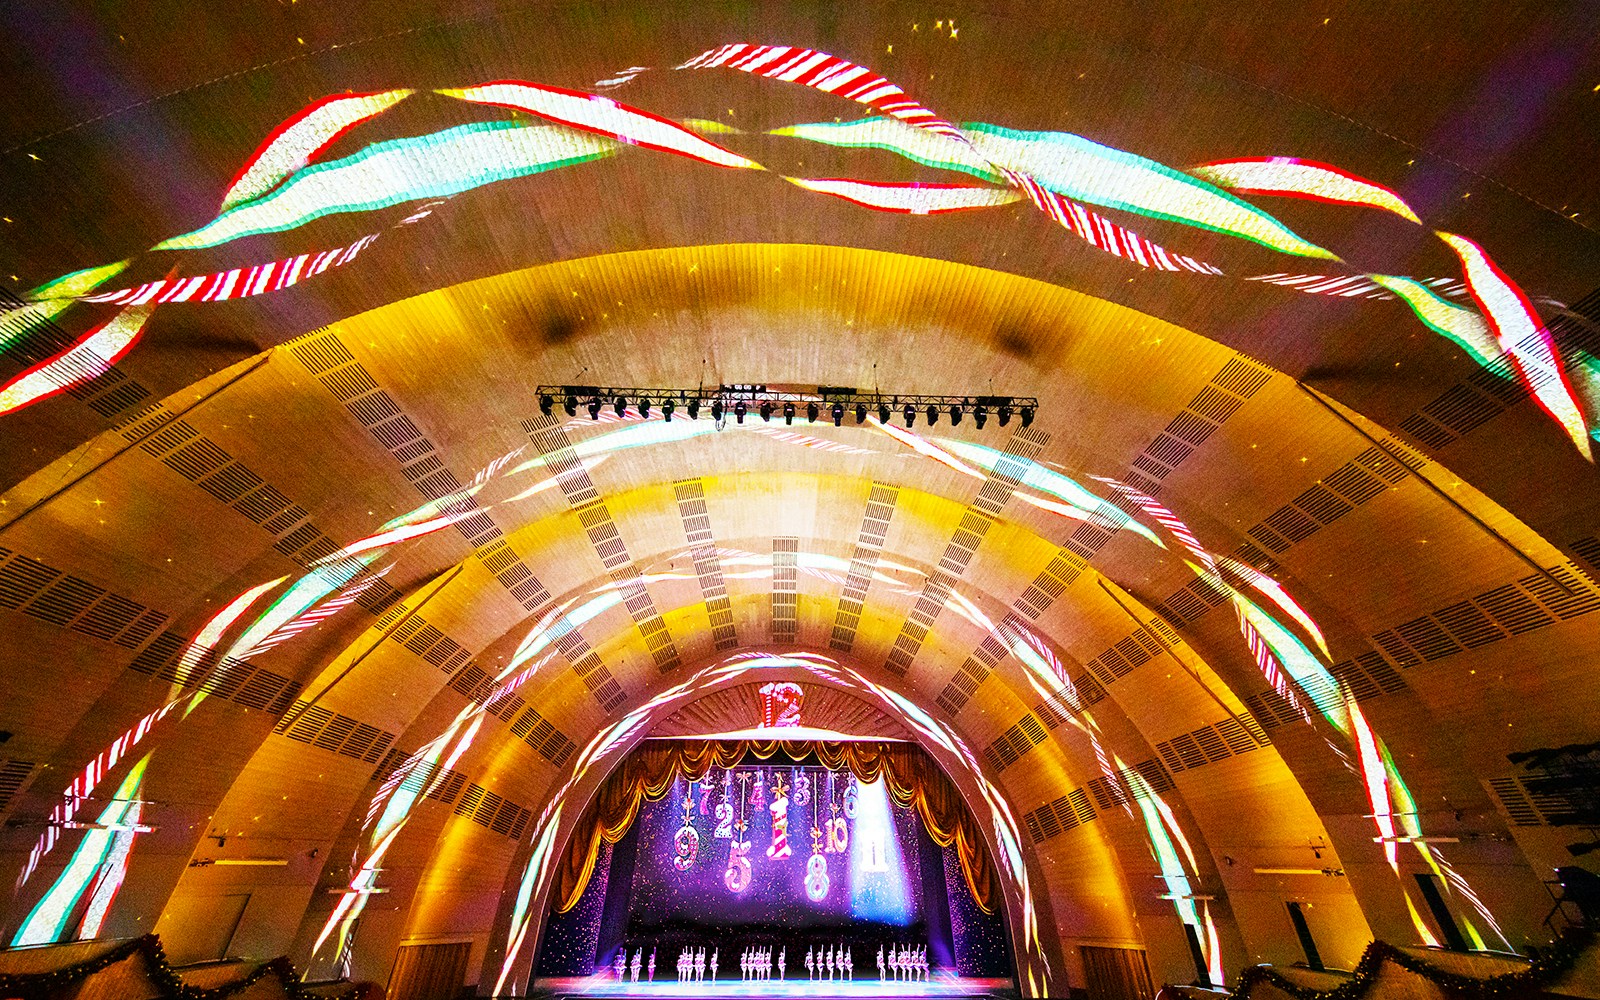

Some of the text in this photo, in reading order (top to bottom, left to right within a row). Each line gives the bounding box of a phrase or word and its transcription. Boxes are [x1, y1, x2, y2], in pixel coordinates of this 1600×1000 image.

[758, 682, 803, 728] 12
[699, 783, 715, 815] 7
[749, 782, 765, 812] 4
[794, 776, 811, 806] 3
[714, 803, 733, 839] 2
[766, 797, 792, 861] 1
[824, 817, 849, 853] 10
[674, 825, 700, 871] 9
[724, 840, 752, 893] 5
[803, 854, 829, 902] 8
